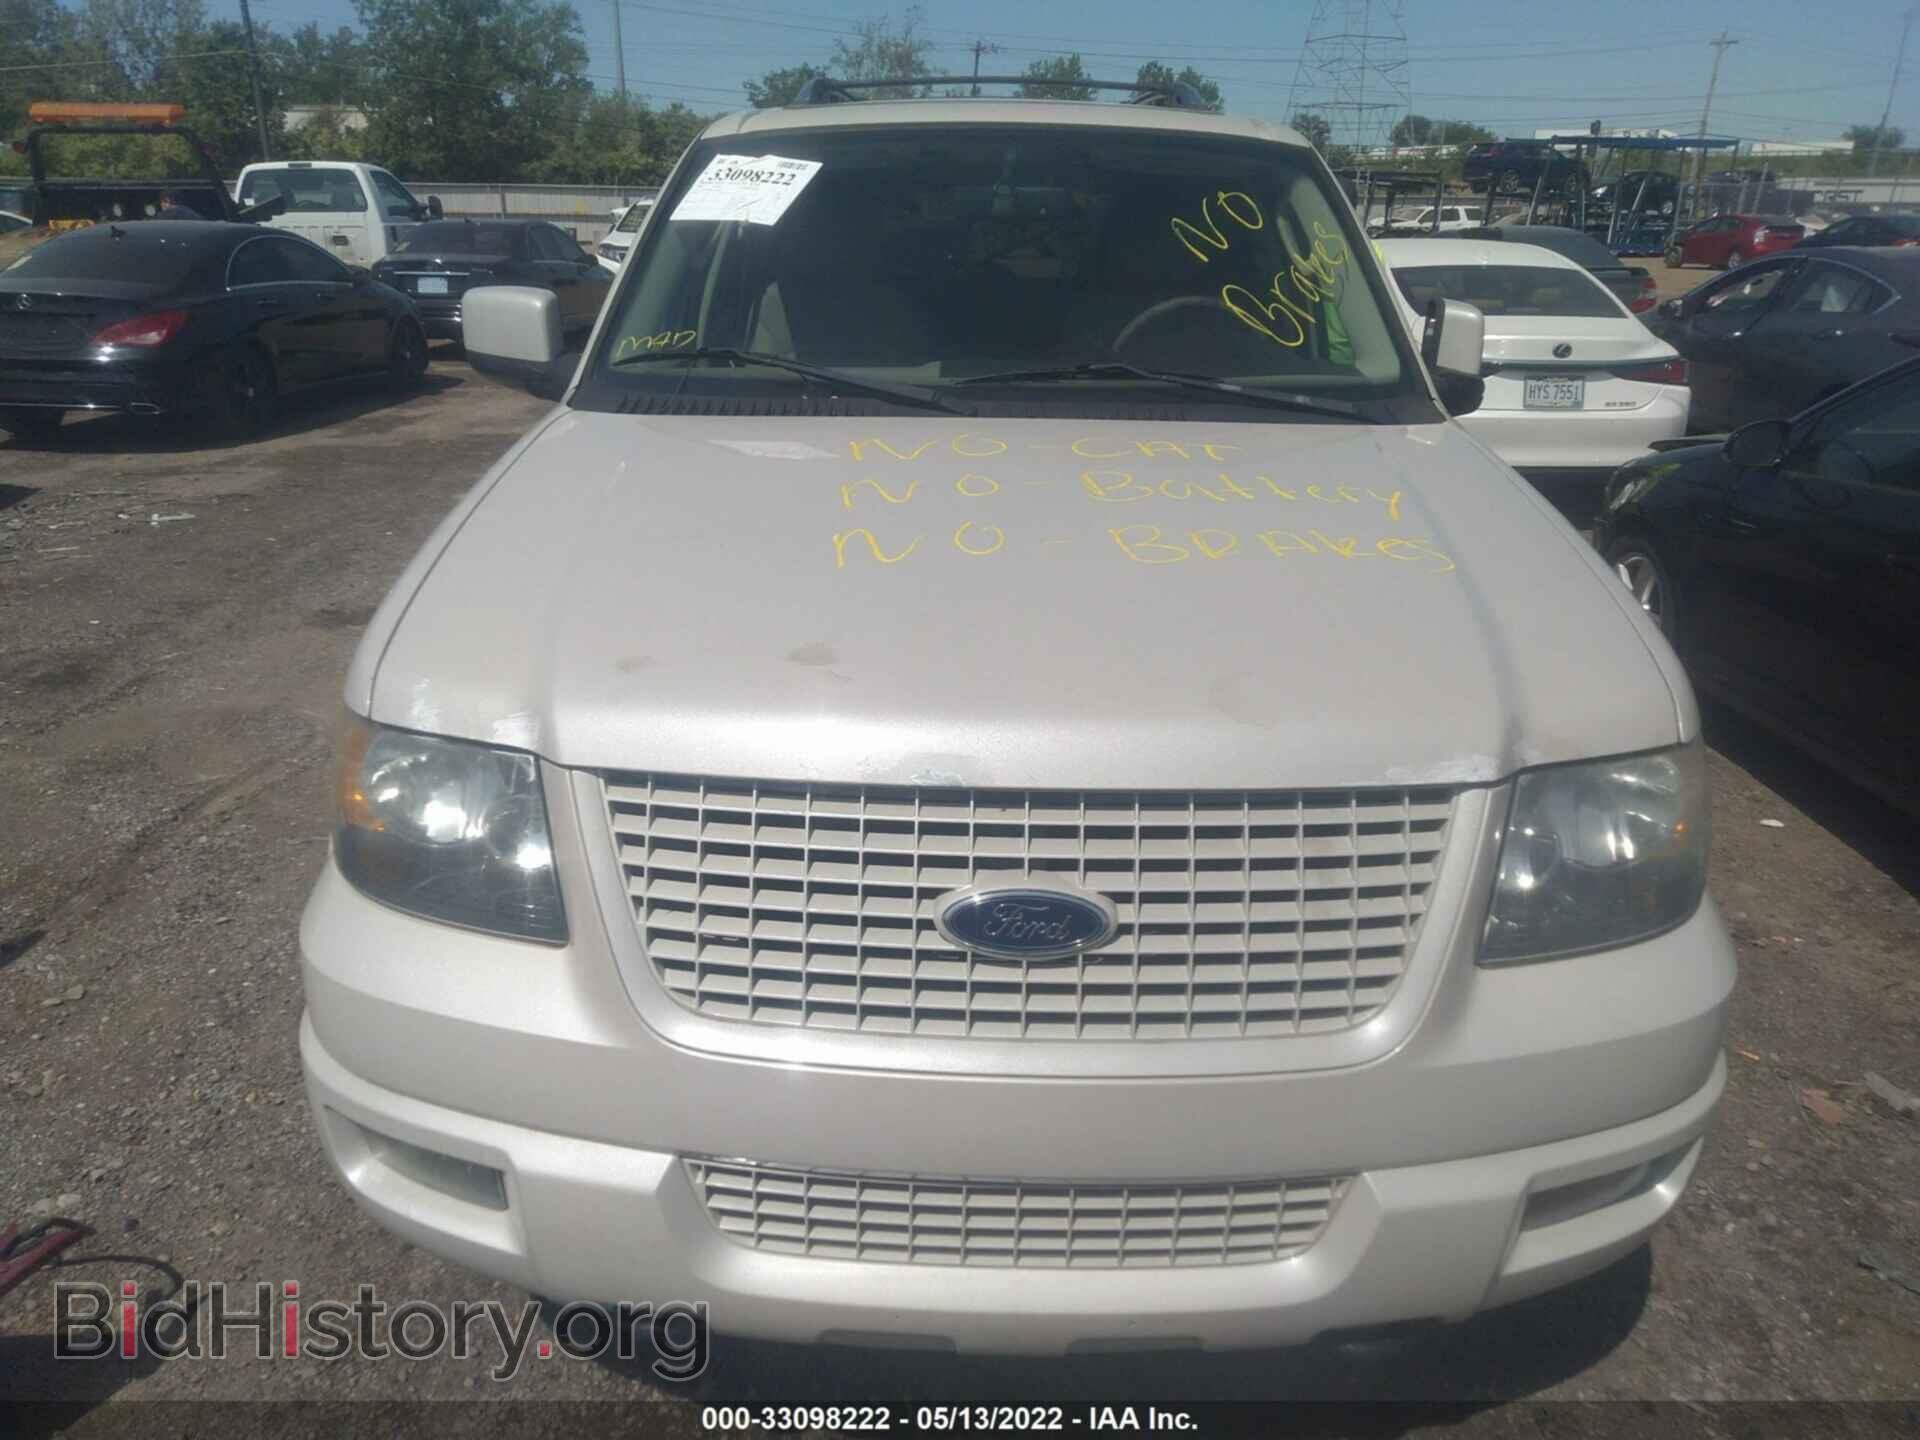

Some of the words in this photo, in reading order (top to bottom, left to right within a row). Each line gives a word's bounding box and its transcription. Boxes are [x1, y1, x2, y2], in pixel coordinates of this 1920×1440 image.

[1171, 191, 1263, 262] NO
[1528, 384, 1551, 400] HYS
[1553, 384, 1578, 400] 7551
[984, 903, 1072, 941] Ford
